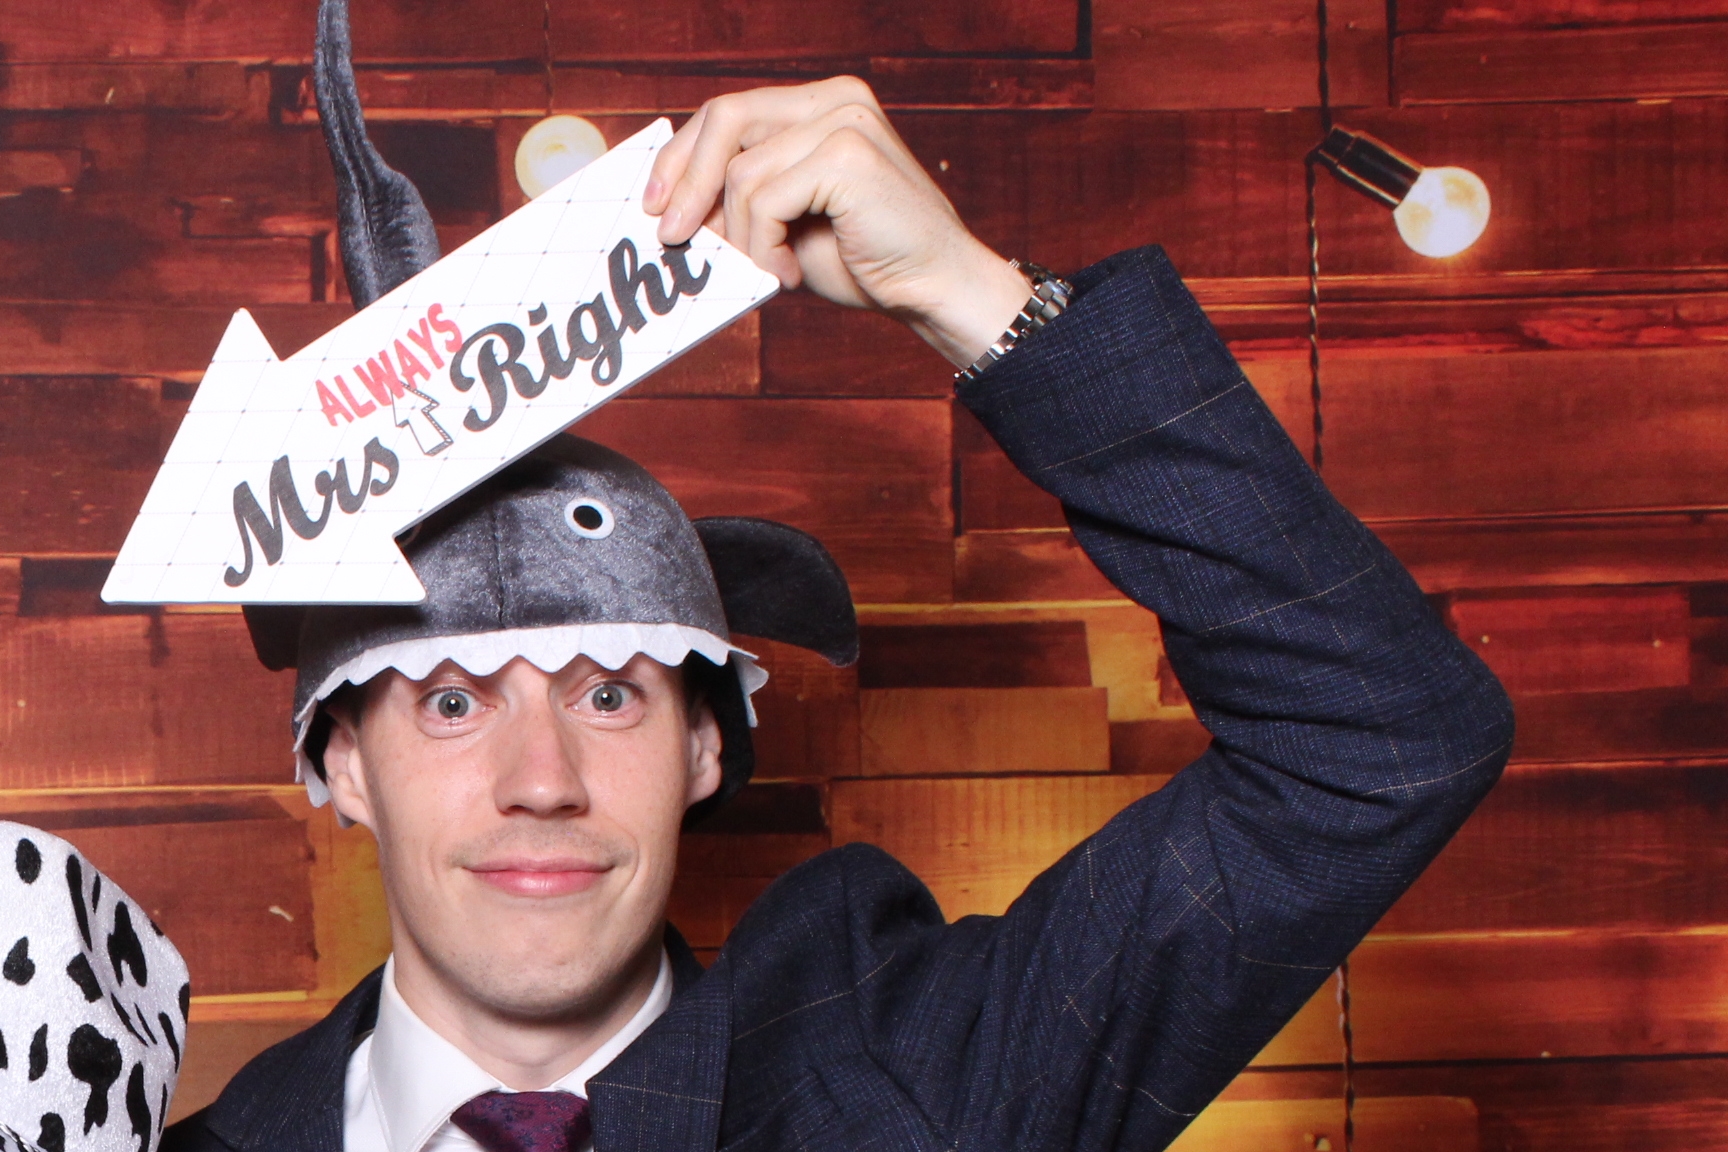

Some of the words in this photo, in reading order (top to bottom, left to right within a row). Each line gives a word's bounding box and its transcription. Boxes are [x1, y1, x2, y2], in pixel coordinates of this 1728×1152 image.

[223, 437, 400, 587] Mrs
[450, 237, 712, 432] Right
[315, 303, 464, 427] ALWAYS
